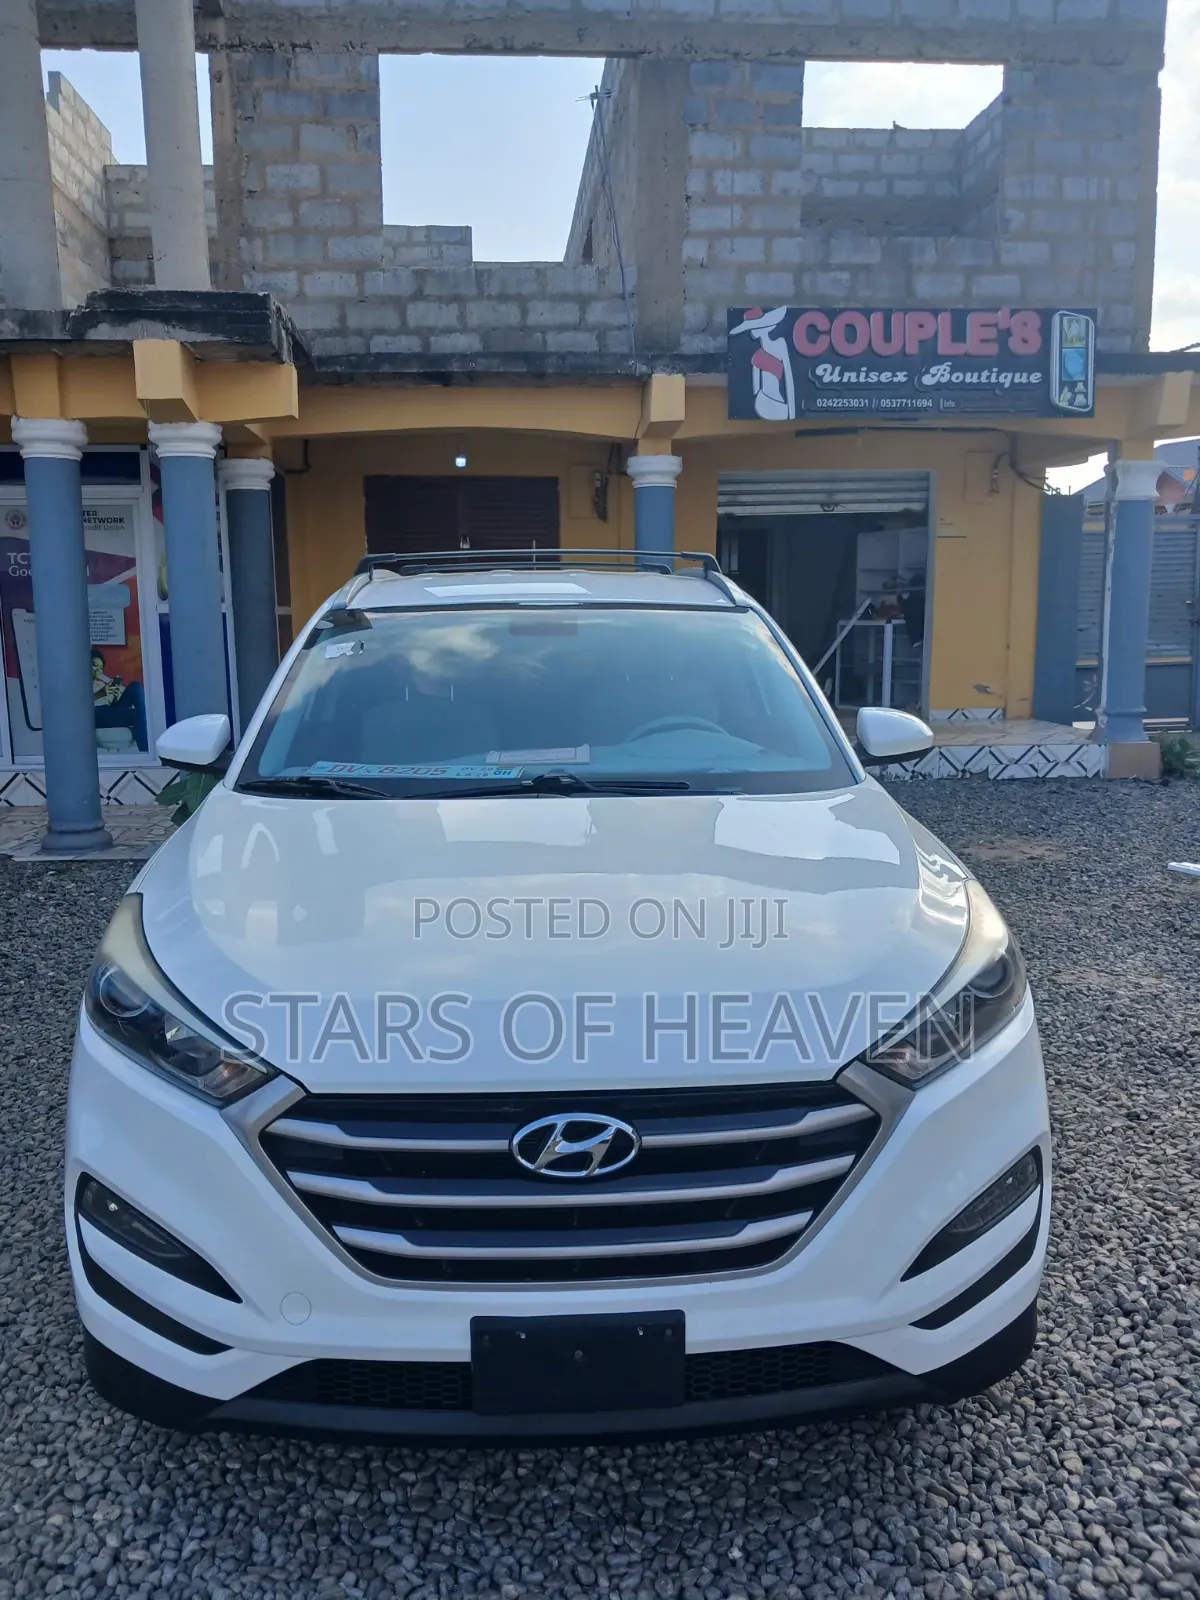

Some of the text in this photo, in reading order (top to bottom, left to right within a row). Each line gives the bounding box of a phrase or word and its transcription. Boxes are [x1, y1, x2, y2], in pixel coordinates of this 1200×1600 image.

[815, 361, 1042, 388] Unisex Boutique
[816, 398, 869, 408] 0242253031
[880, 398, 933, 408] 0537711694
